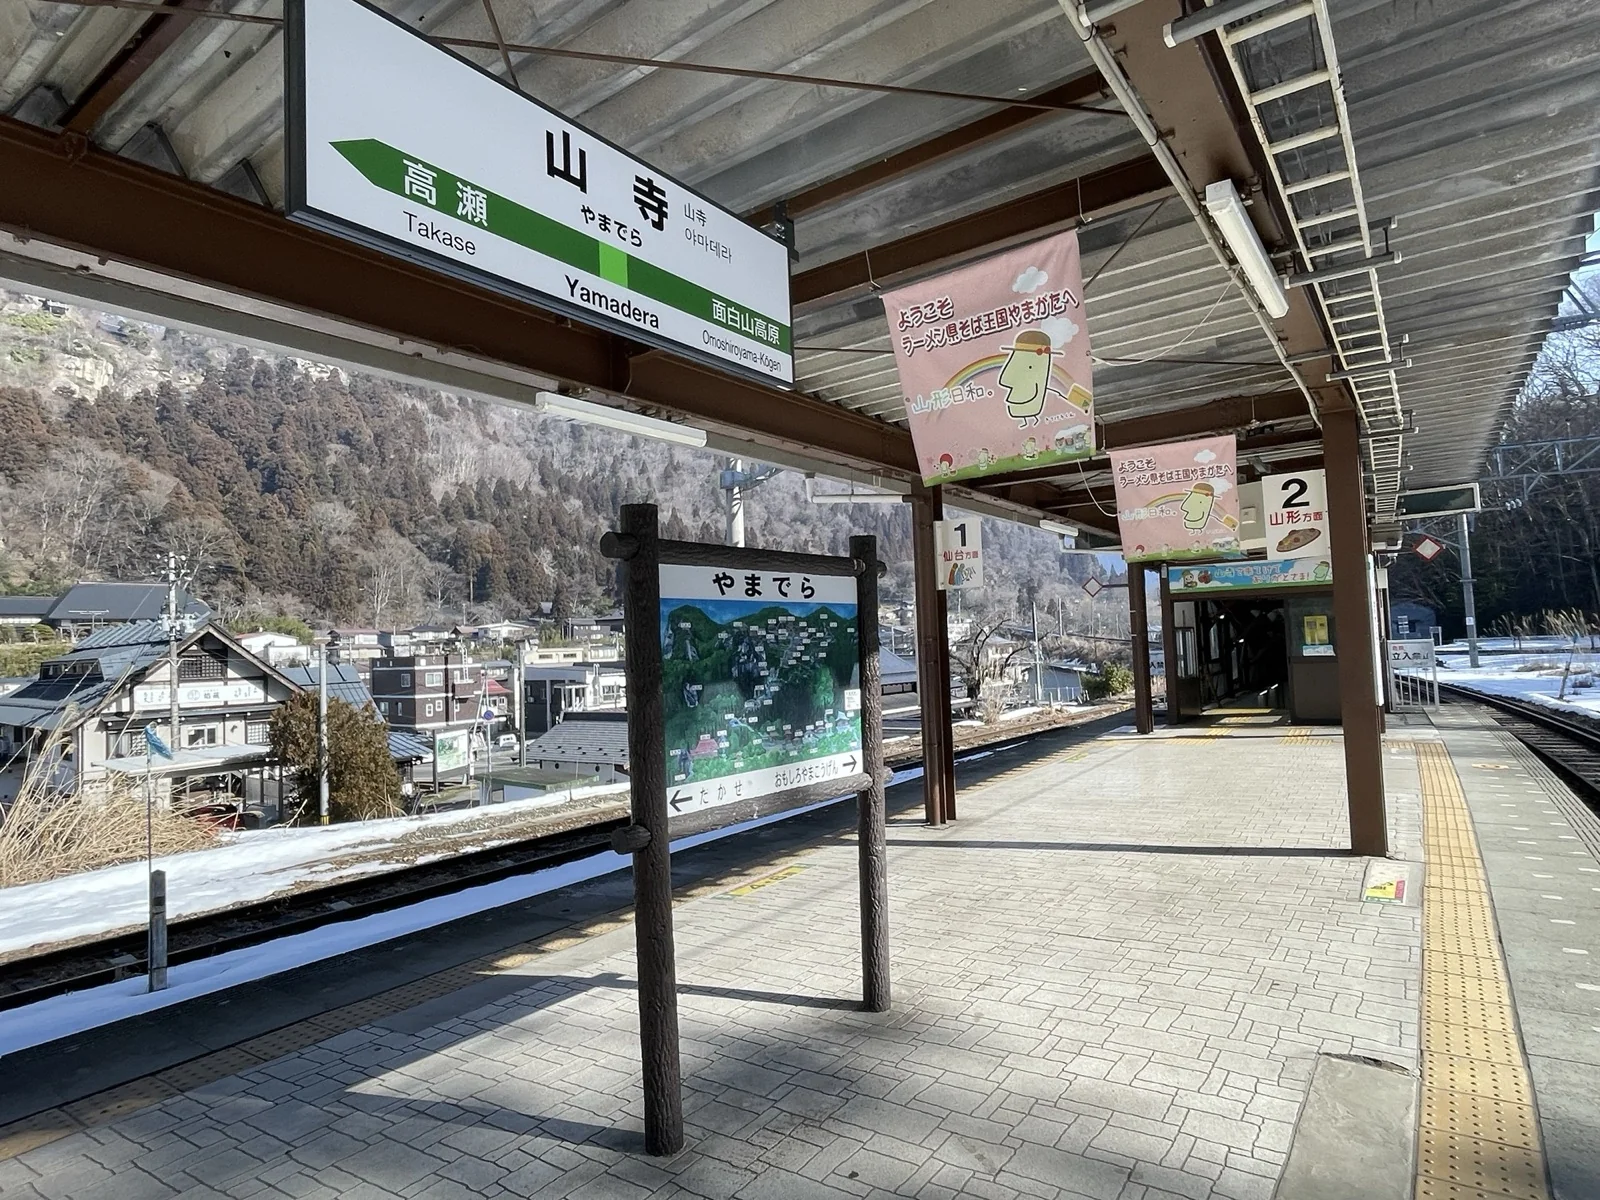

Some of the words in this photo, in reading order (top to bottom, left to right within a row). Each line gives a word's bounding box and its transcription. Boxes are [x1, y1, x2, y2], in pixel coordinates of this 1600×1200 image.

[402, 158, 489, 228] 高瀬
[545, 130, 668, 232] 山寺
[580, 204, 644, 248] やまでら
[684, 202, 707, 228] 山寺
[402, 211, 476, 256] Takase
[684, 228, 733, 265] 야마데라
[565, 274, 660, 330] Yamadera
[898, 296, 954, 330] ようこそ
[711, 298, 780, 345] 面白山高原
[901, 288, 1080, 356] ラーメン県そば王国やまがたへ
[1118, 458, 1156, 474] ようこそ
[1120, 464, 1234, 488] ラーメン県そば王国やまがたへ
[1280, 478, 1311, 510] 2
[1269, 510, 1323, 526] 山形方面
[954, 523, 967, 547] 1
[712, 571, 816, 599] やまでら
[774, 759, 839, 788] おもしろやまこうげん
[700, 781, 743, 805] たかせ
